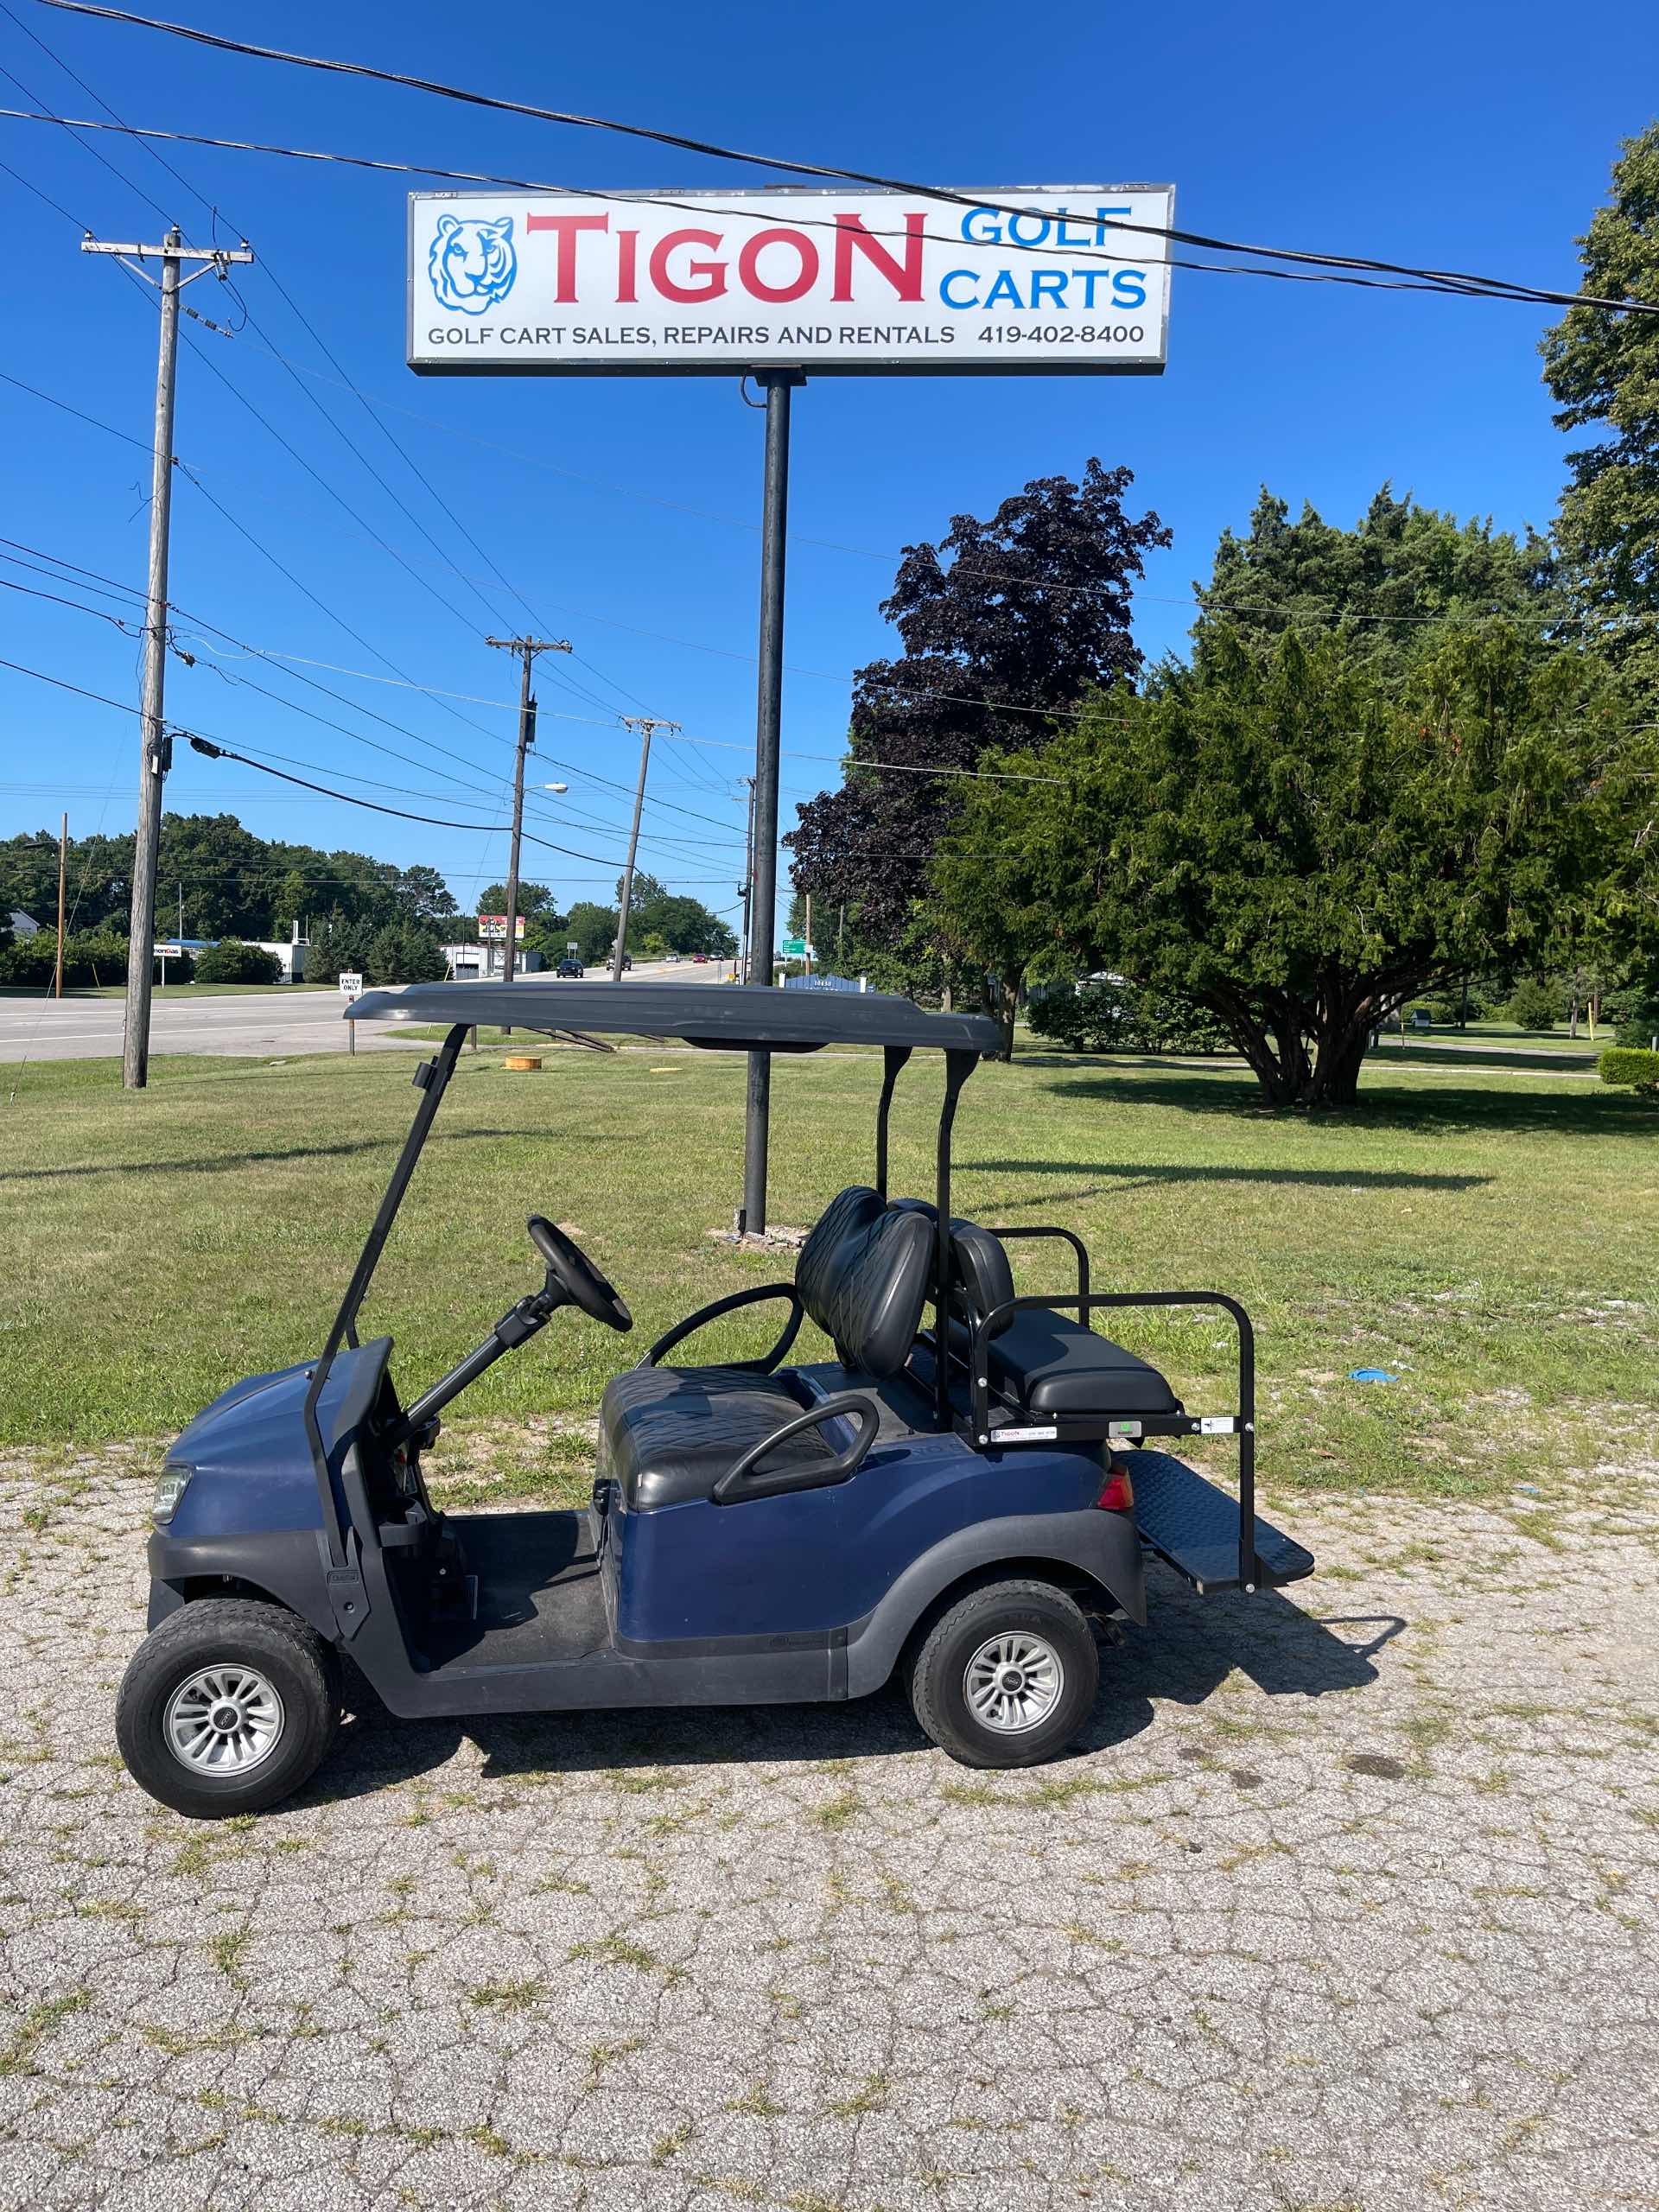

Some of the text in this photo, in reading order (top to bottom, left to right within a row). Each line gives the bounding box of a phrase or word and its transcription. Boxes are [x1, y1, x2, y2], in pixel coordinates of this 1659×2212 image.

[961, 207, 1132, 247] GOLF
[527, 213, 928, 303] TIGON
[939, 269, 1147, 310] CARTS
[428, 325, 1144, 347] GOLF CART SALES, REPAIRS AND RENTALS 419-402-8400
